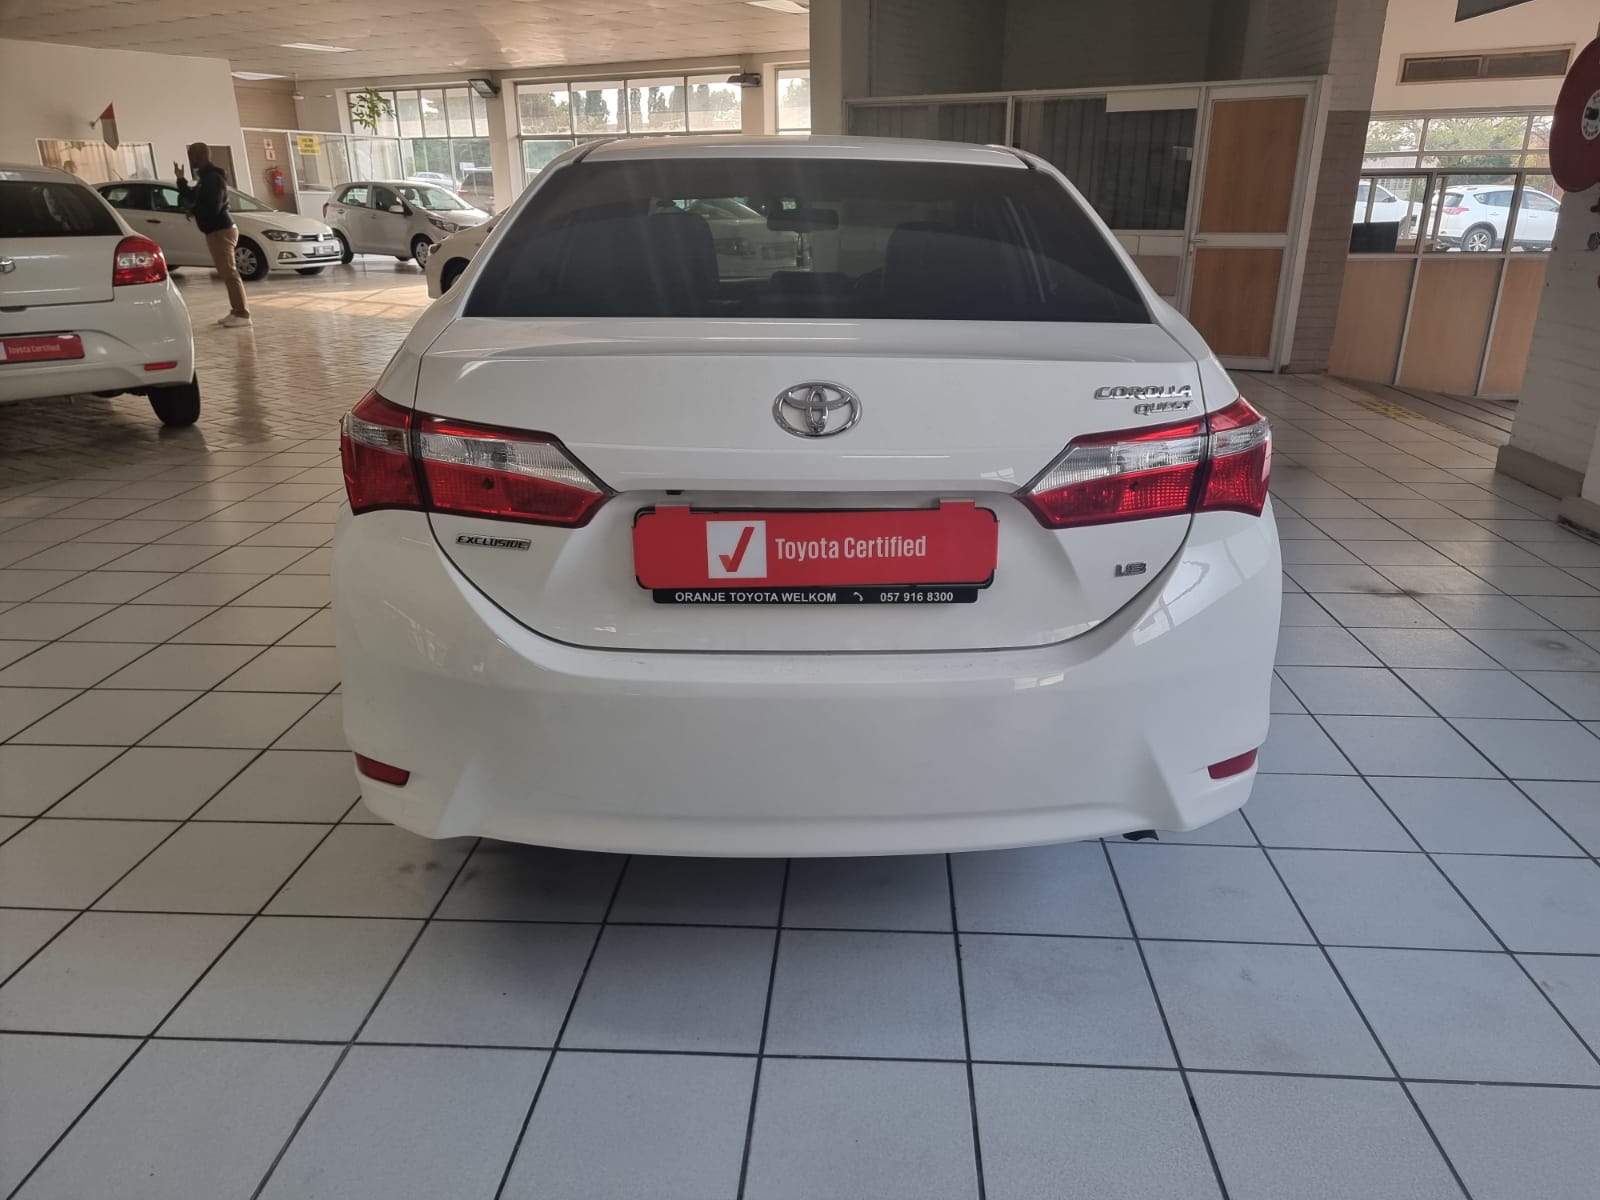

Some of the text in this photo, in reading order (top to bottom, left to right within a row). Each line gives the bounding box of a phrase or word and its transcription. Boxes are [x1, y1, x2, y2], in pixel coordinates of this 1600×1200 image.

[1094, 385, 1192, 400] COROLLA
[1134, 400, 1193, 415] QUEST
[456, 534, 530, 551] EXCLUSIVE
[775, 535, 927, 562] Toyota Certified
[675, 591, 954, 602] ORANJE TOYOTA WELKOM 057 916 8300
